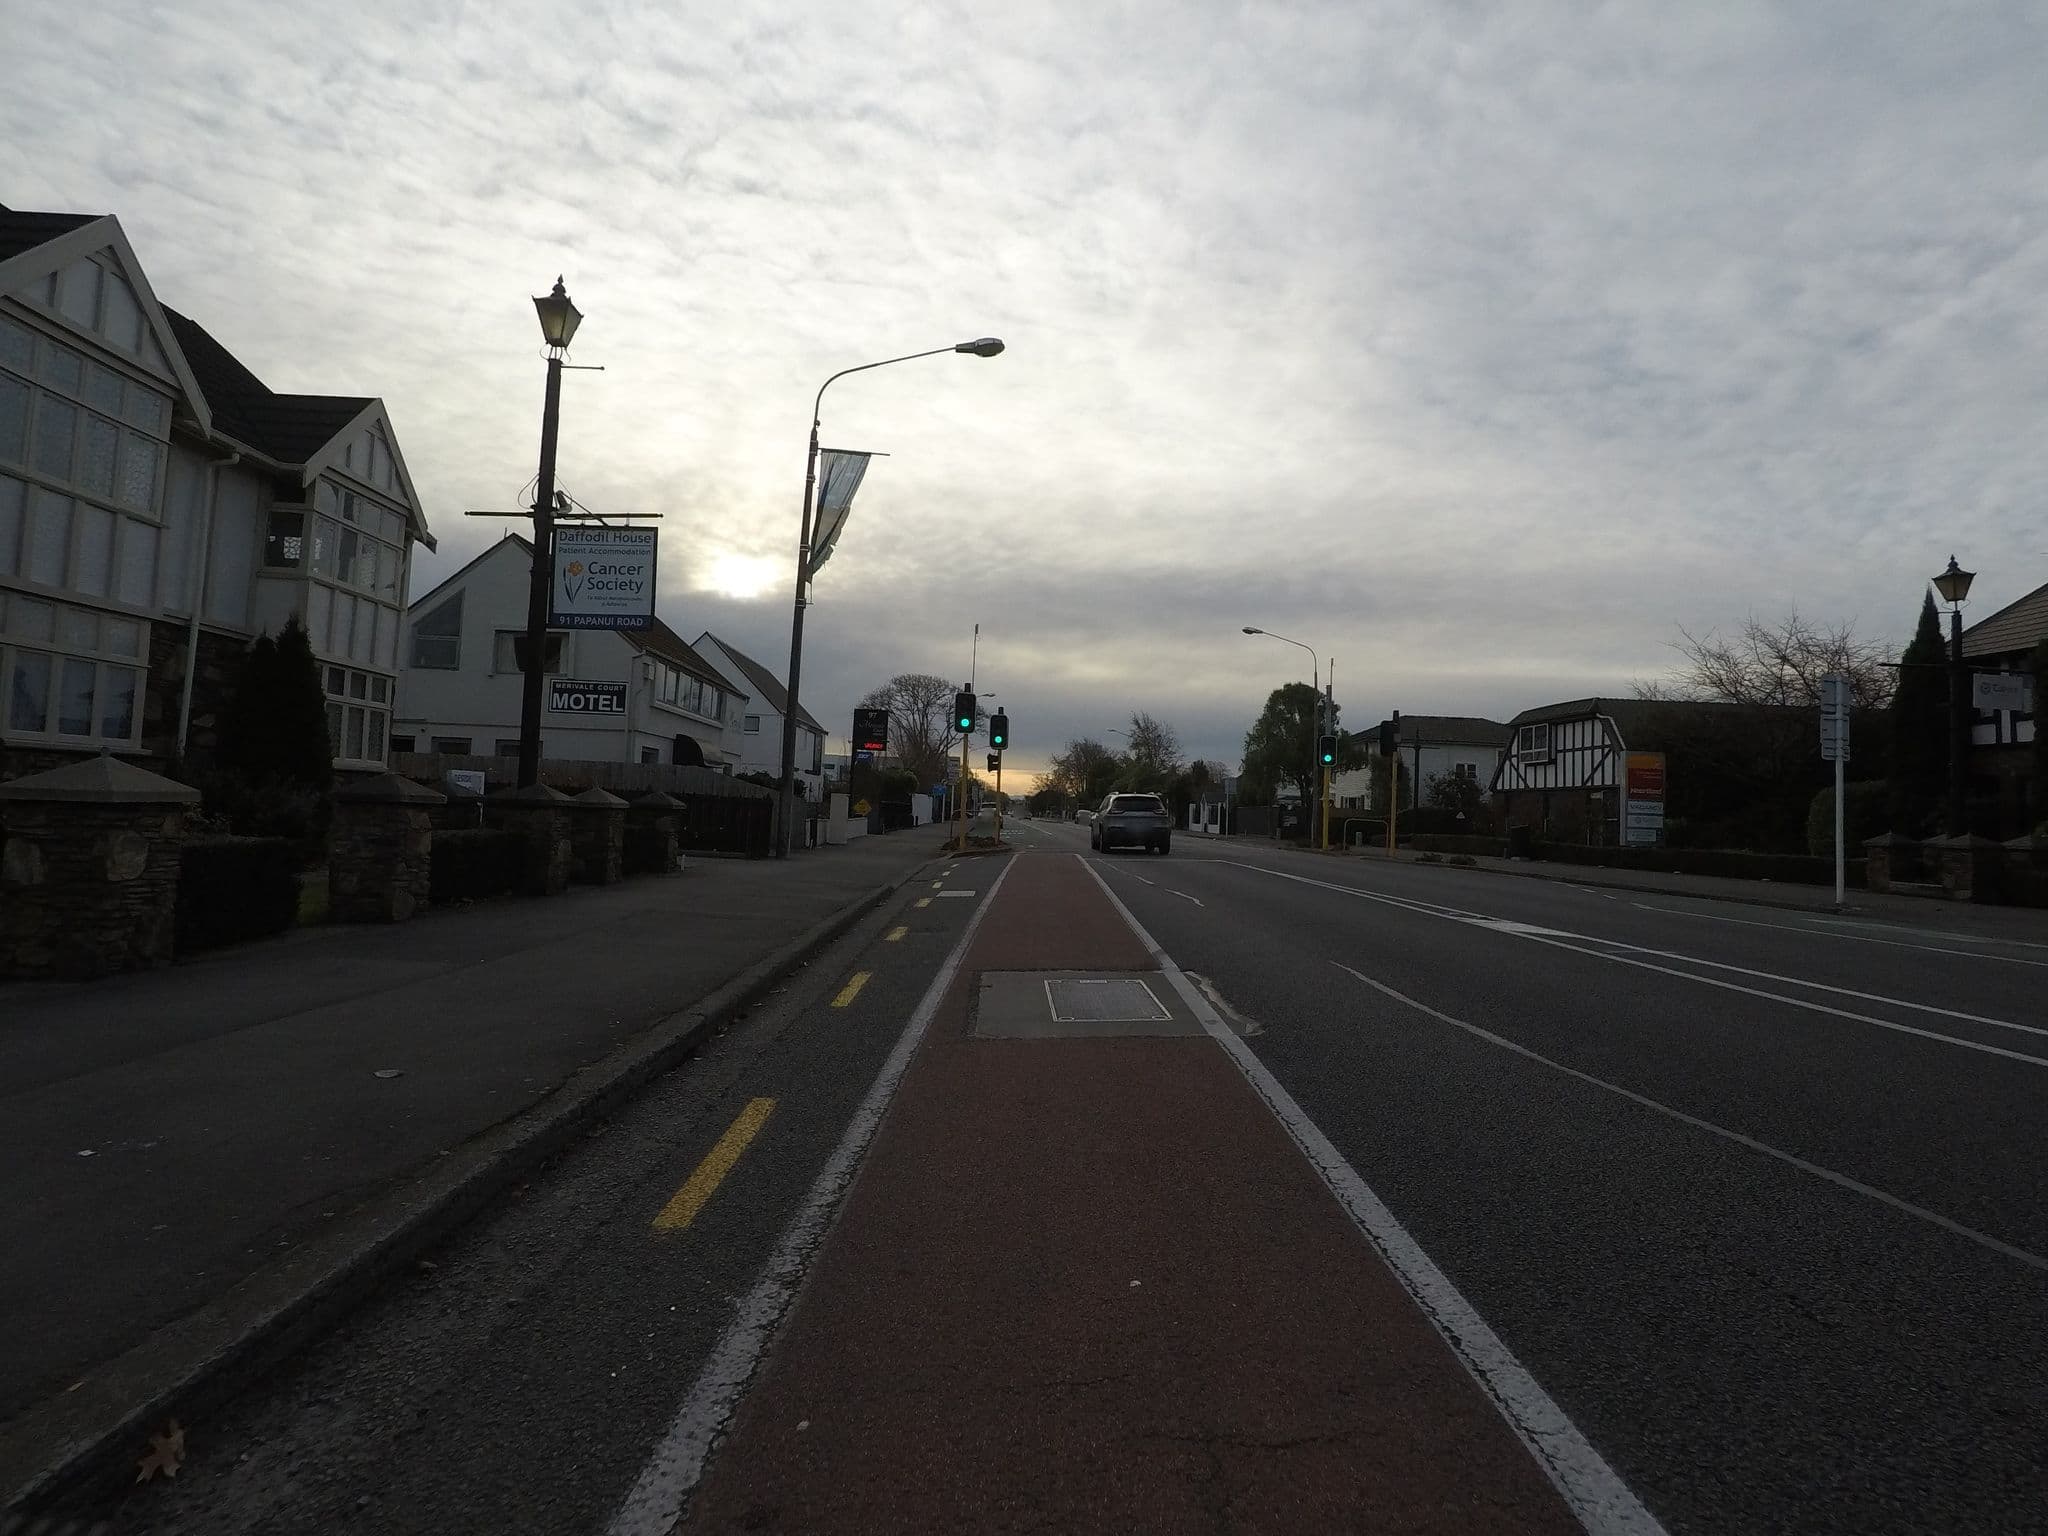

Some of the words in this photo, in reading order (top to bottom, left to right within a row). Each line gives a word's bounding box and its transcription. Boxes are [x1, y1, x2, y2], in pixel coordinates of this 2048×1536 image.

[559, 530, 609, 543] Daffodil
[613, 532, 652, 544] House
[558, 546, 586, 554] Patient
[589, 547, 651, 556] Accommodation
[588, 561, 644, 576] Cancer
[587, 577, 644, 594] Society
[559, 616, 571, 625] 91
[574, 616, 614, 626] PAPANUI
[616, 617, 643, 627] ROAD
[555, 682, 594, 691] MERIVALE
[552, 692, 624, 712] MOTEL
